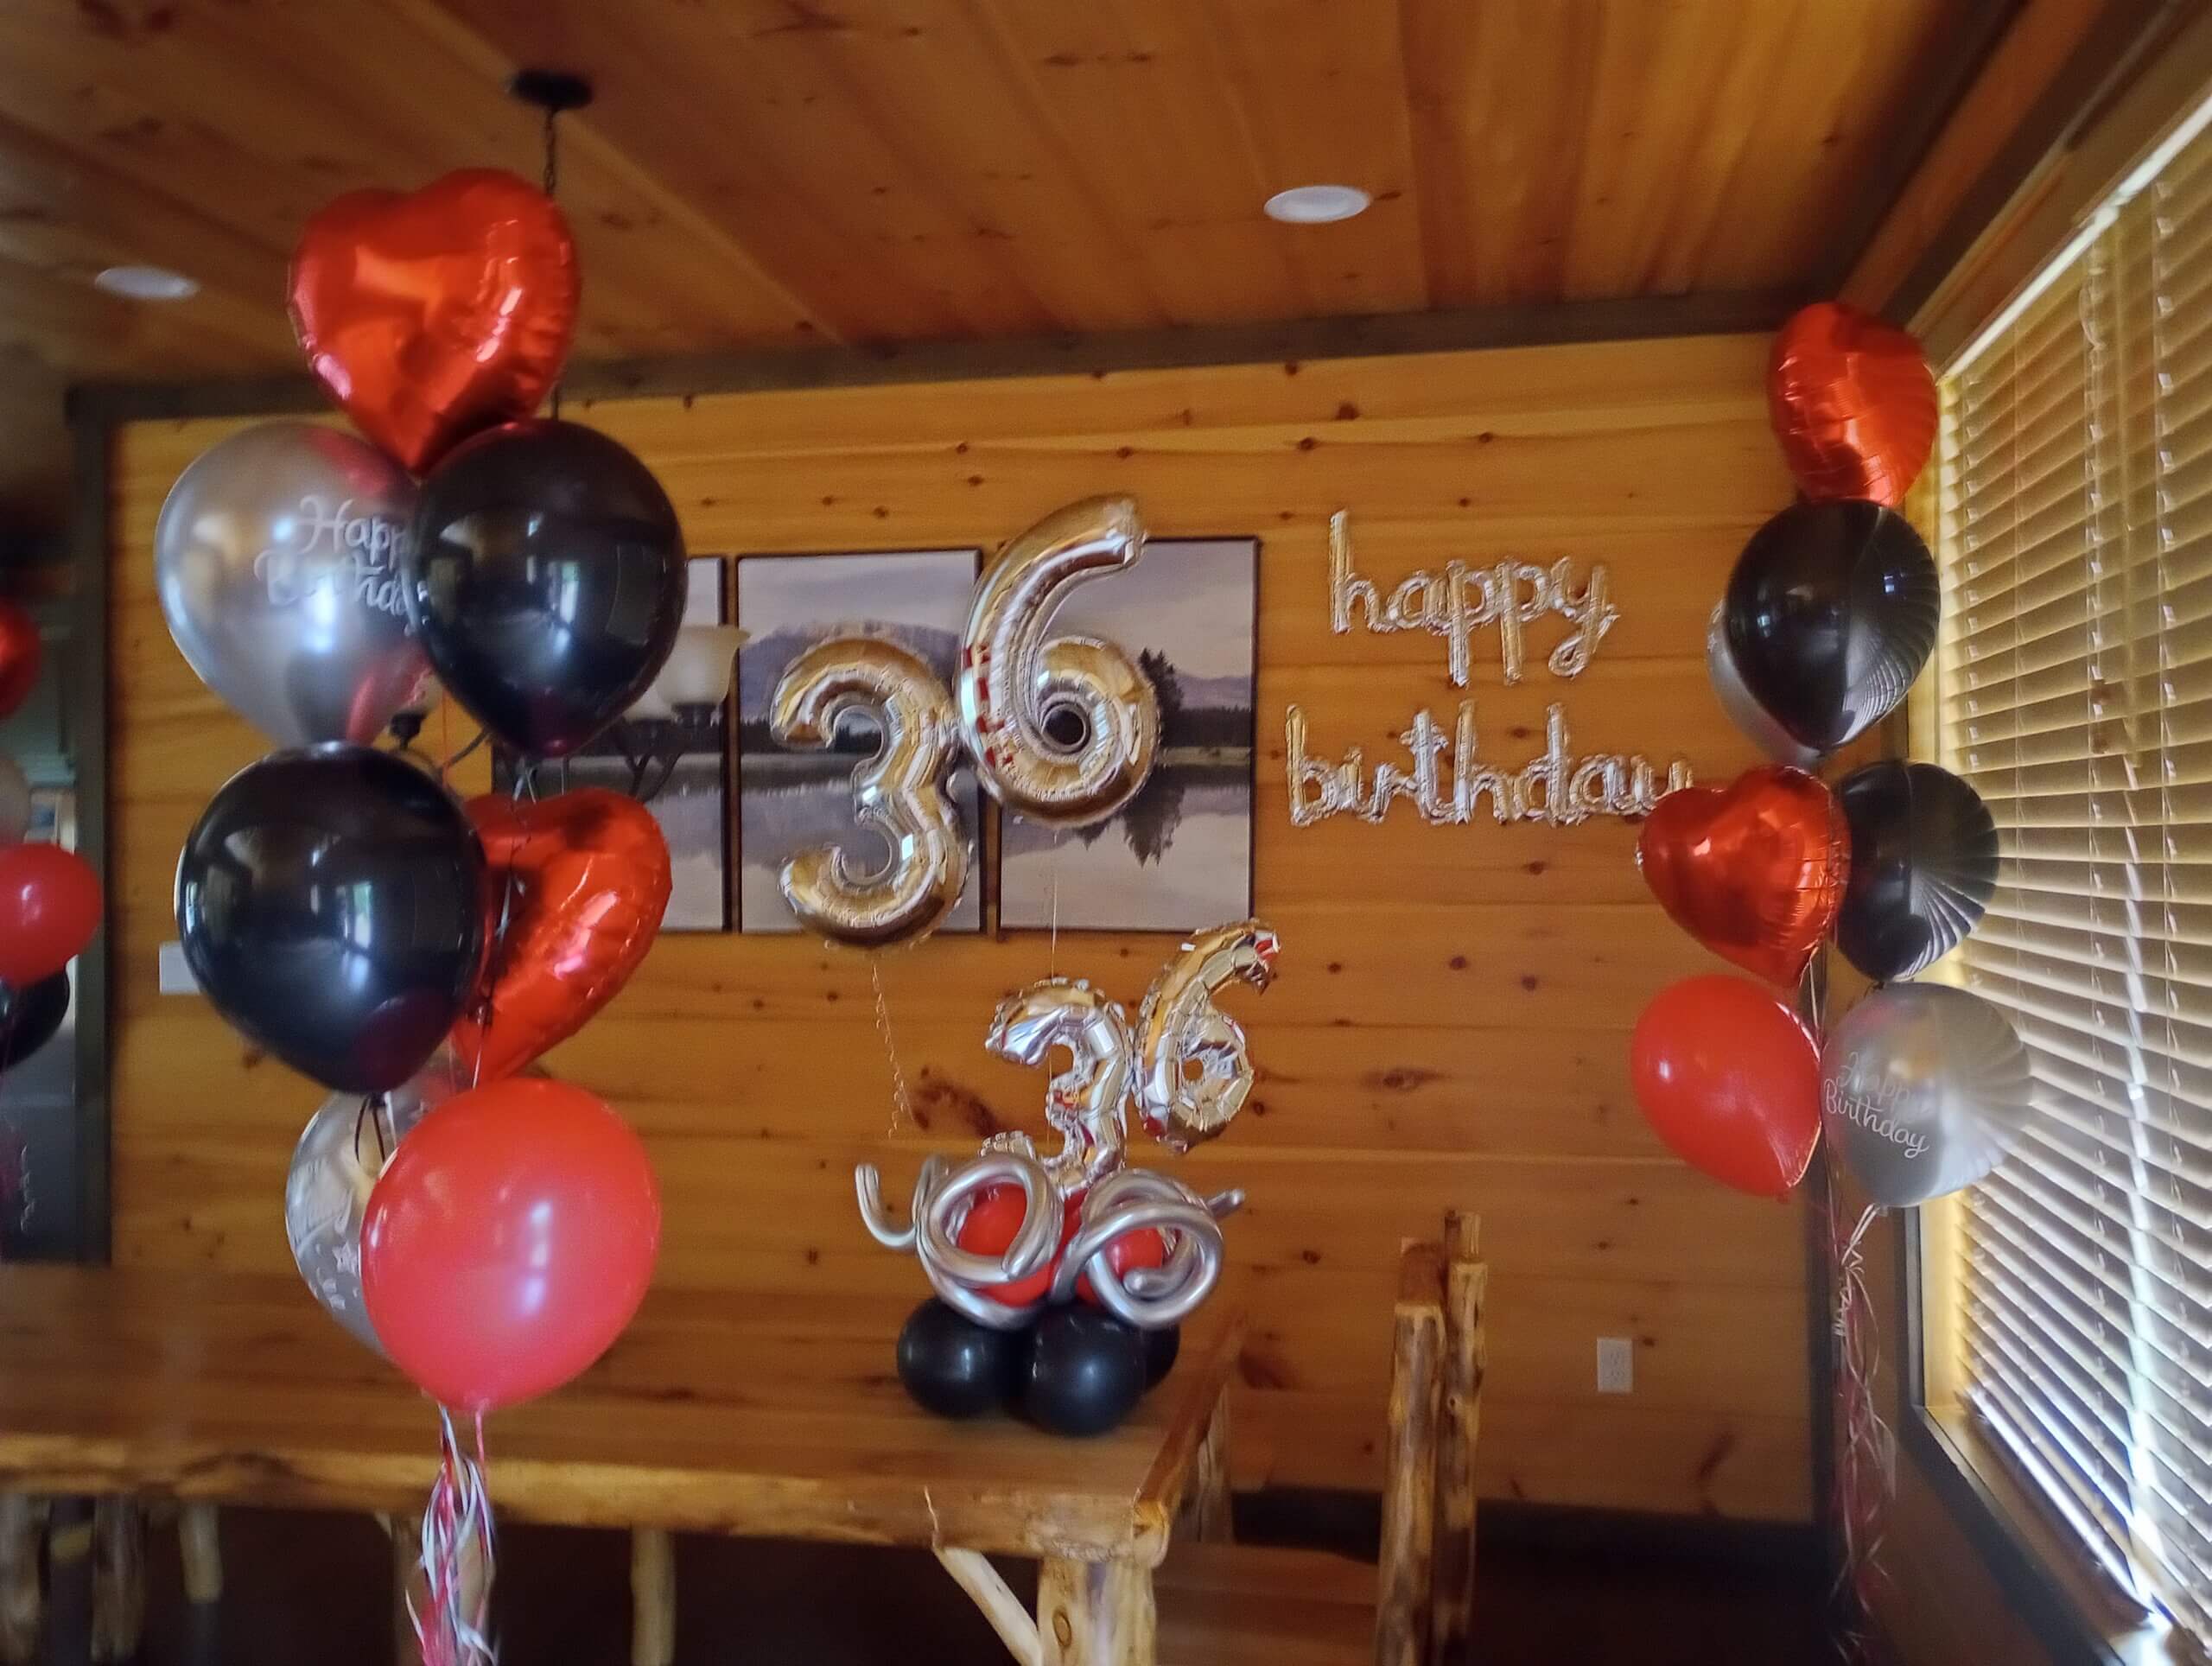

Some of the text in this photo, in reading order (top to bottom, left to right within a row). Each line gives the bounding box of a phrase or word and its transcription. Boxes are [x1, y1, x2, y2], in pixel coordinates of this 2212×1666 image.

[299, 495, 408, 572] Happ
[1329, 509, 1621, 688] happy
[1824, 1078, 1930, 1159] Birthday
